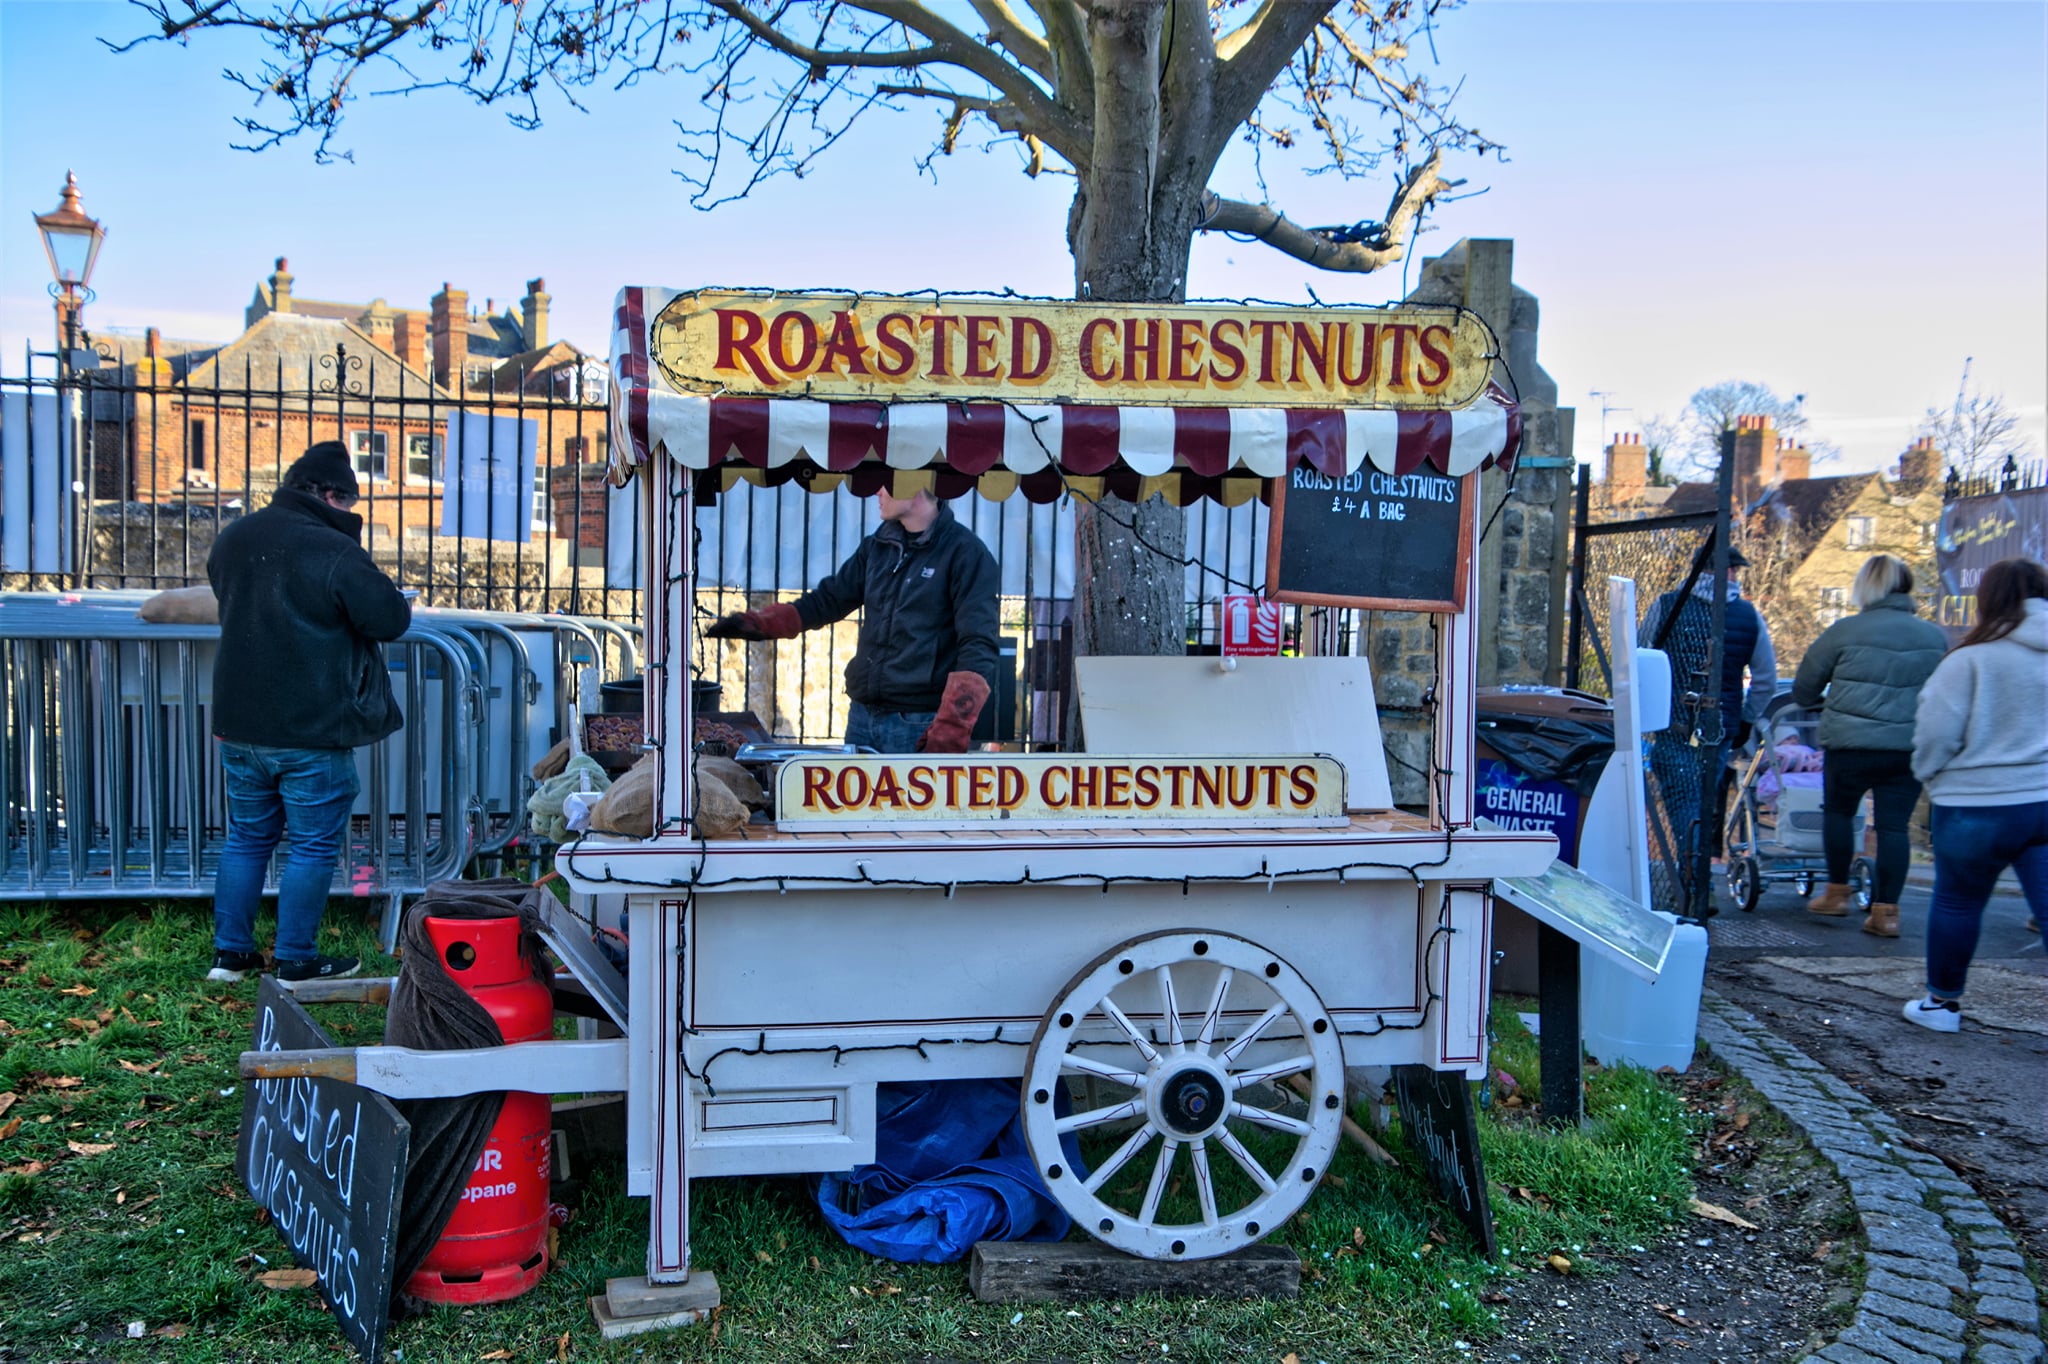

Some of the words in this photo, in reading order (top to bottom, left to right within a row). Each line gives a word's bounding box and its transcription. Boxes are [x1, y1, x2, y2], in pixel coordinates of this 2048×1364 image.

[710, 308, 1058, 387] ROASTED
[1078, 317, 1453, 392] CHESTNUTS
[1293, 467, 1363, 493] ROASTED
[1369, 471, 1456, 503] CHESTNUTS
[1331, 496, 1357, 514] £4
[1359, 500, 1371, 519] A
[1379, 502, 1406, 521] BAG
[802, 765, 1027, 810] ROASTED
[1039, 765, 1318, 809] CHESTNUTS
[1486, 786, 1566, 817] GENERAL
[461, 1181, 518, 1203] opane
[248, 1114, 360, 1319] Chestnuts
